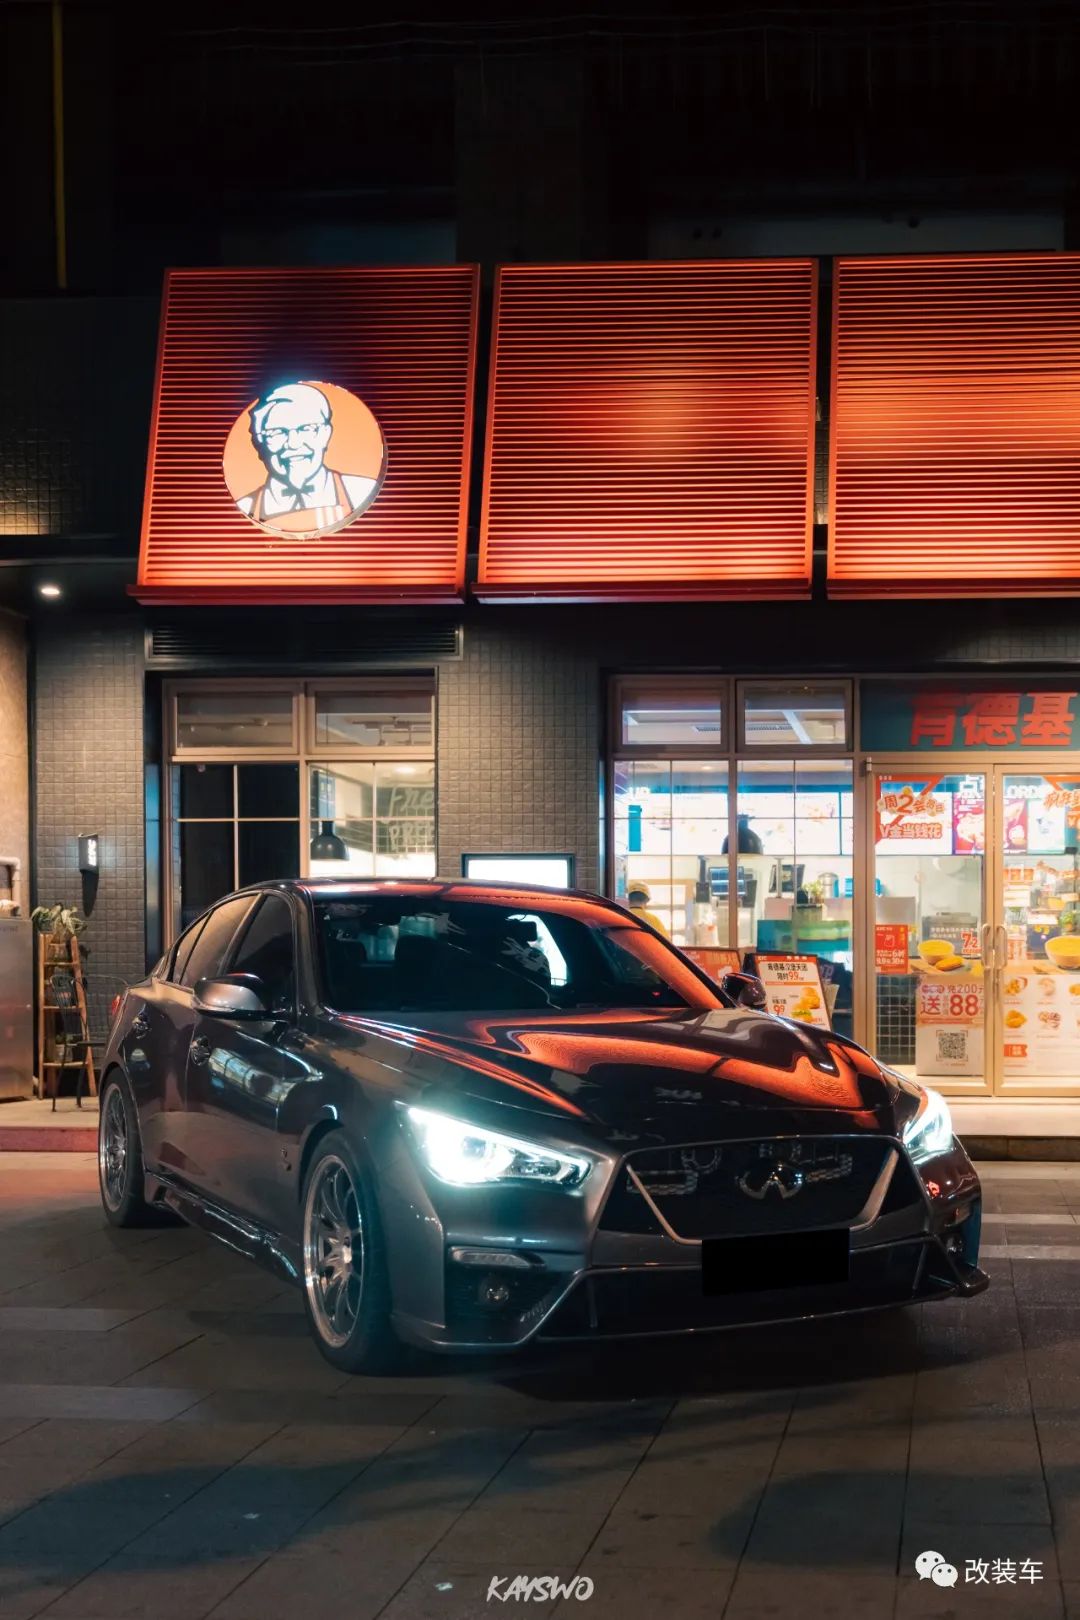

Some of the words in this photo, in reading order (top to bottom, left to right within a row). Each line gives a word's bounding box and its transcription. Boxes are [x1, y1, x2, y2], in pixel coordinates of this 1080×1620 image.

[909, 692, 1079, 746] 肯德基
[920, 994, 941, 1015] 送
[950, 994, 979, 1015] 88
